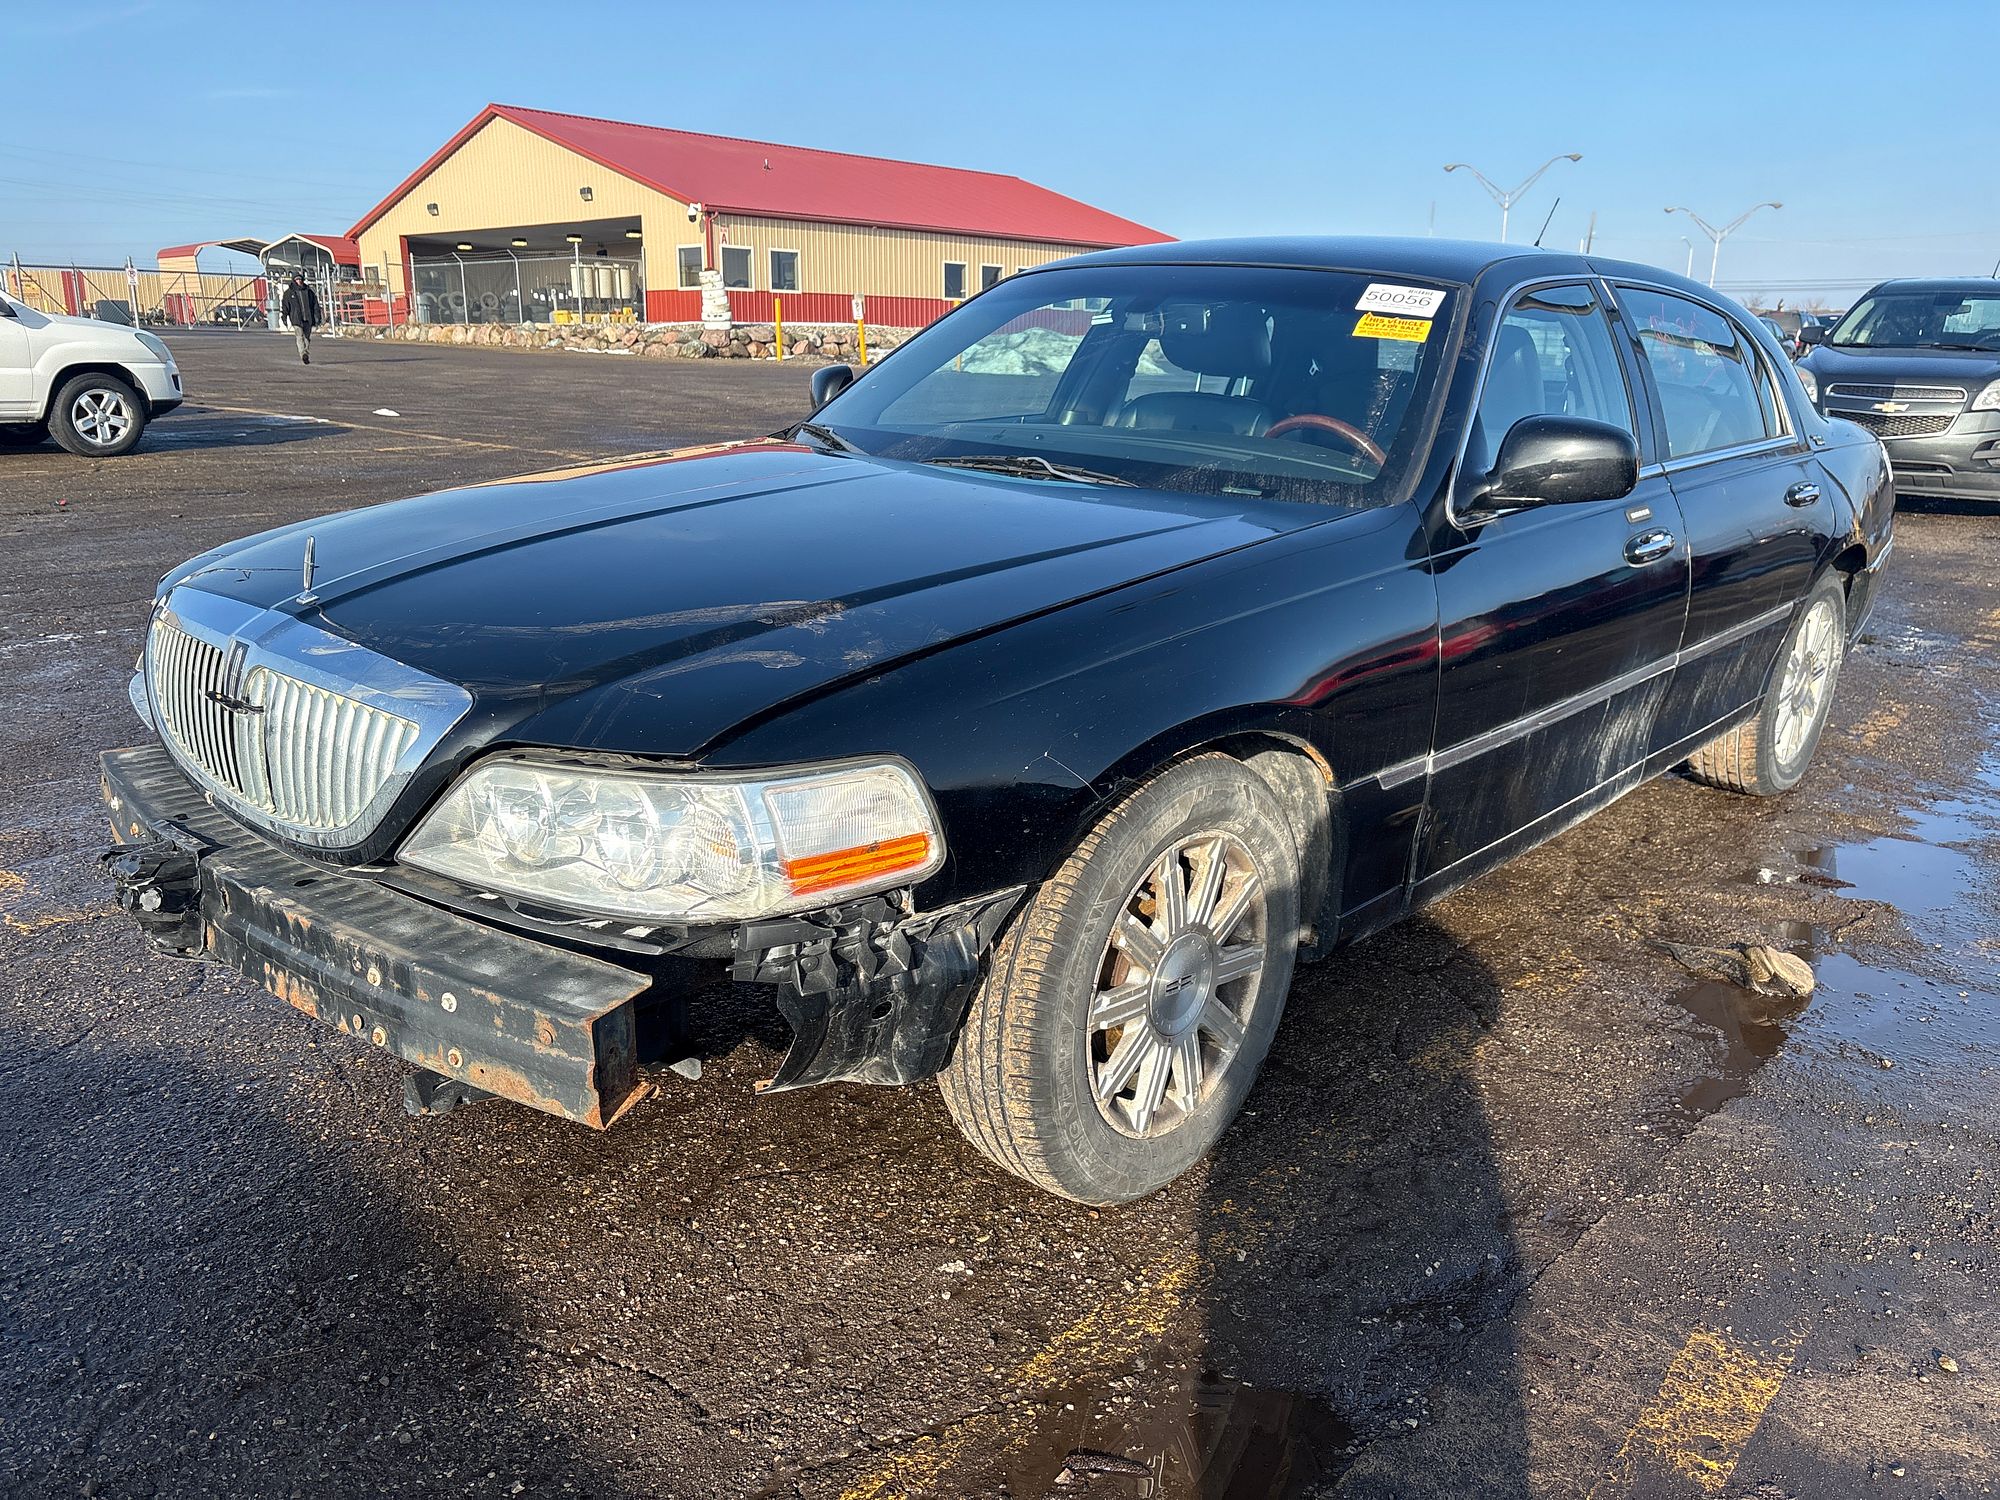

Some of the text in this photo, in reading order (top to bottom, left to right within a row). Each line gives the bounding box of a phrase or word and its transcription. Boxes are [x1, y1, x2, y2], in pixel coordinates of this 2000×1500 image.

[1366, 291, 1432, 306] 50056
[1364, 313, 1426, 328] THIS VEHICLE
